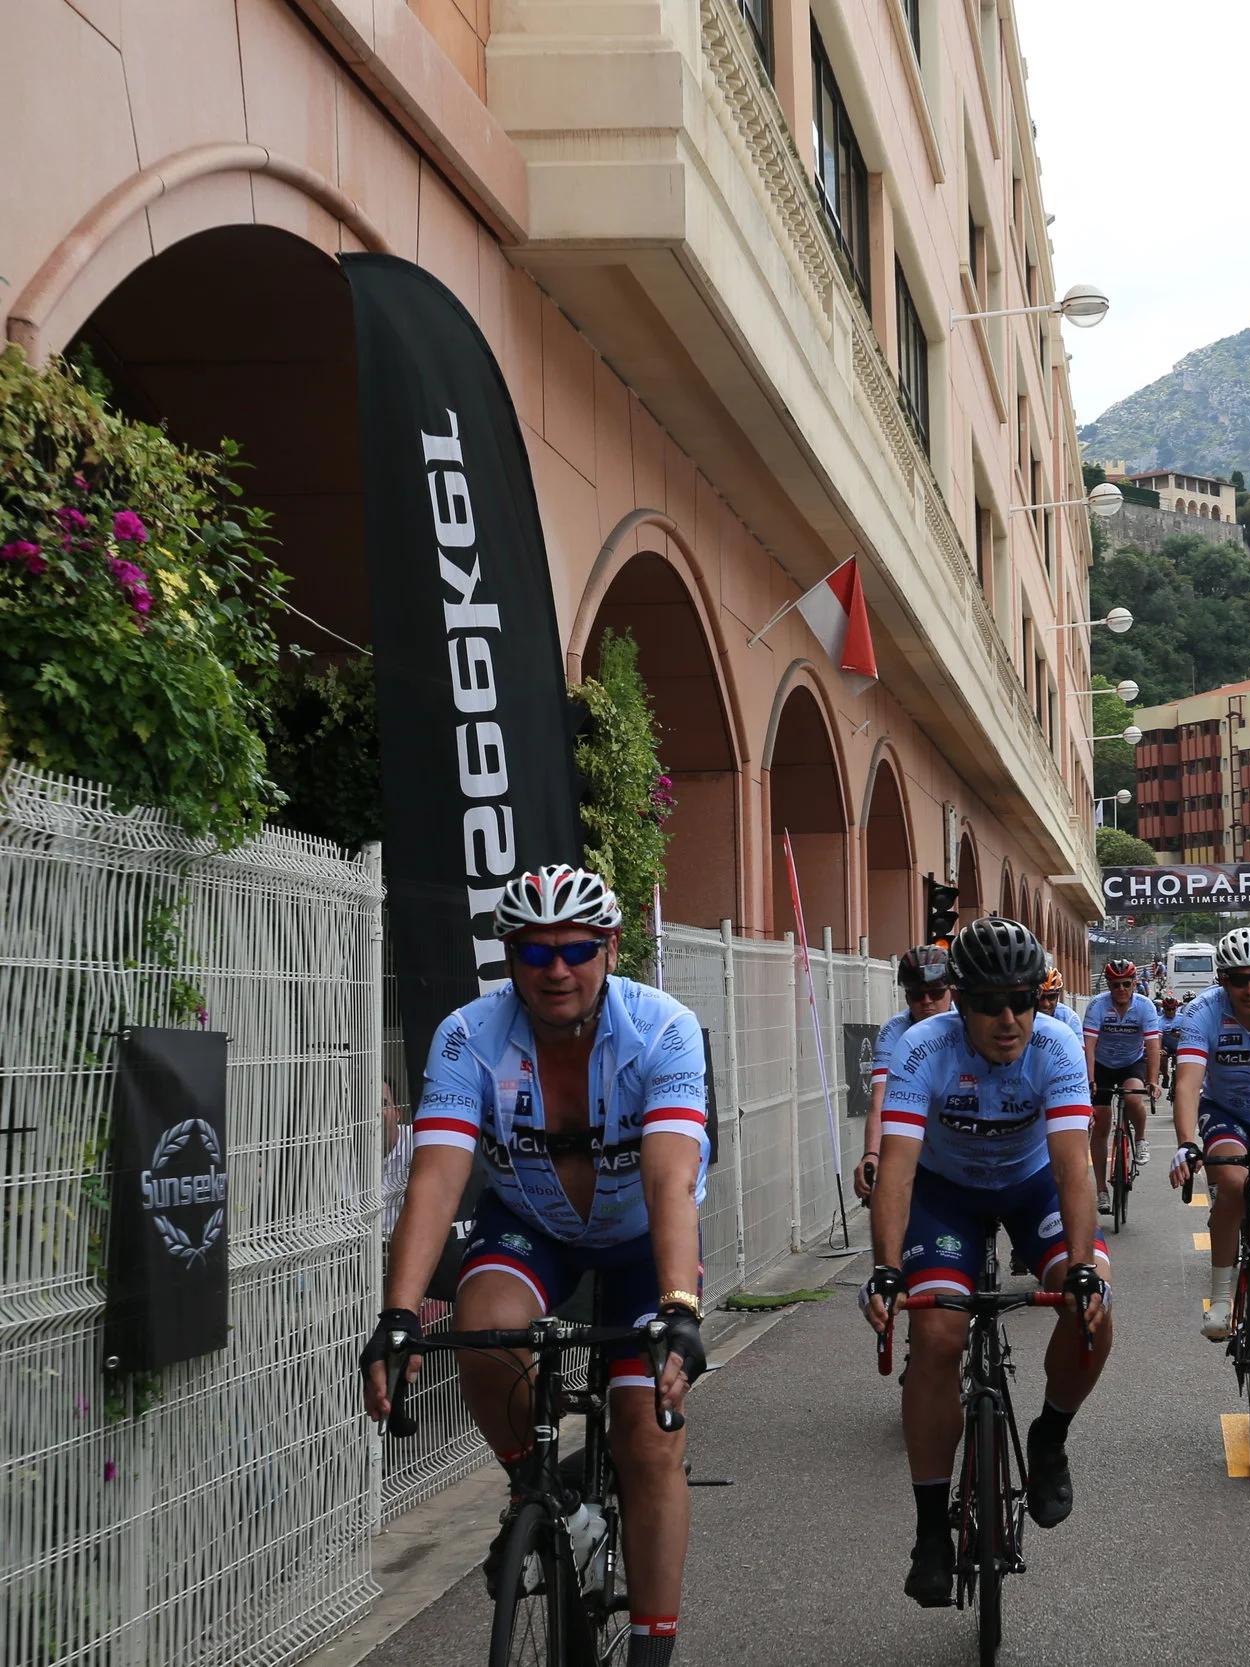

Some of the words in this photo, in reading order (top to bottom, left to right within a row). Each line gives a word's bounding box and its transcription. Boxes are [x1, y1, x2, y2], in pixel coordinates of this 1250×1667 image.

[1130, 896, 1184, 905] OFFICIAL
[889, 1090, 929, 1104] BOUTSE
[533, 1331, 545, 1343] 3T
